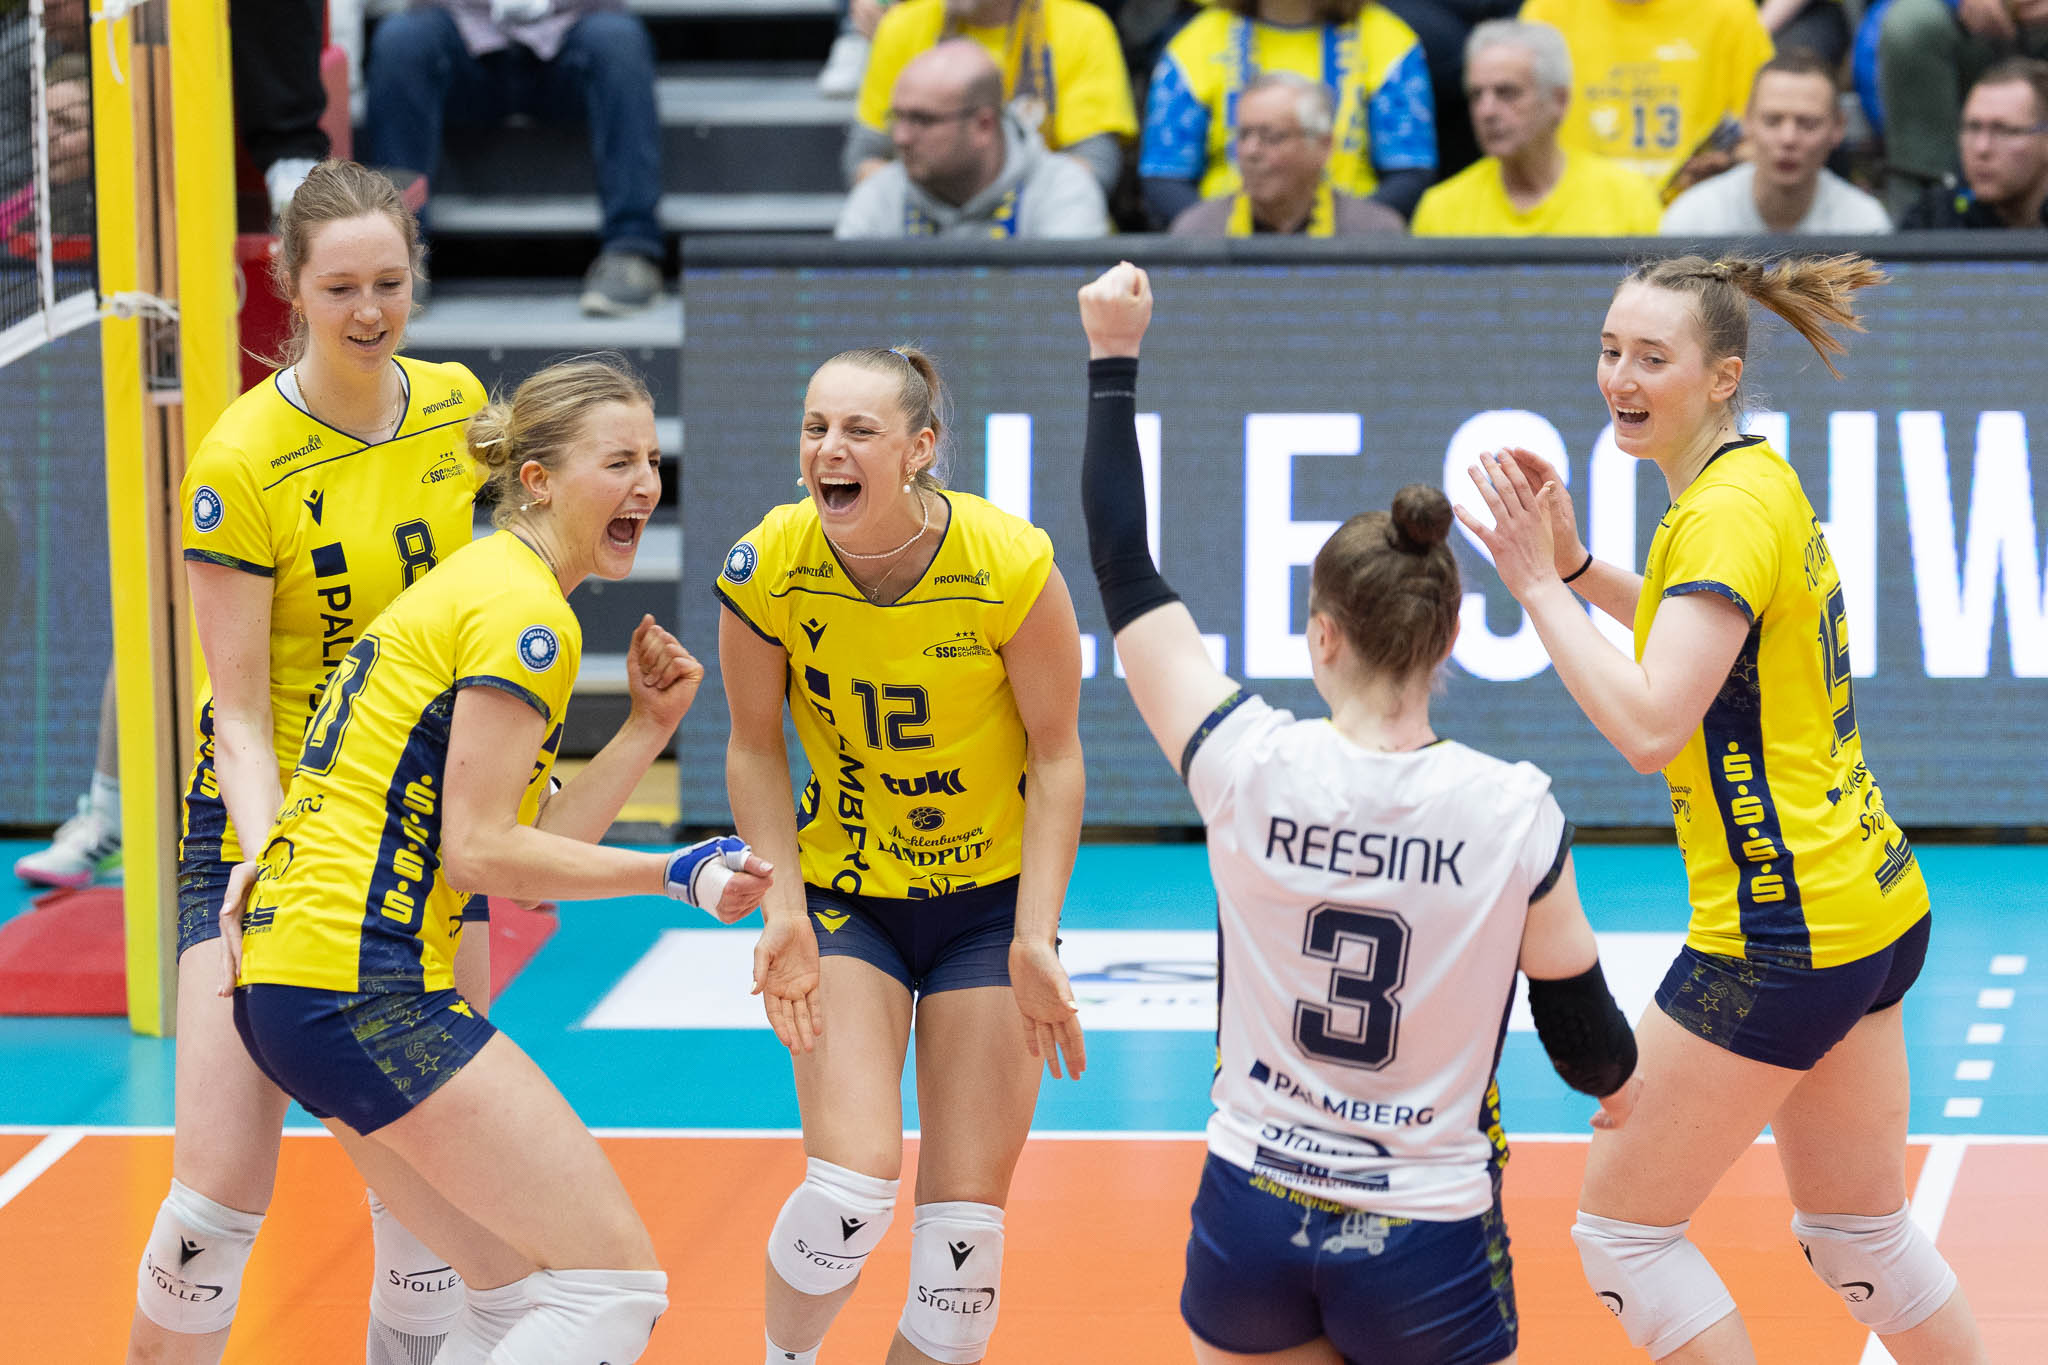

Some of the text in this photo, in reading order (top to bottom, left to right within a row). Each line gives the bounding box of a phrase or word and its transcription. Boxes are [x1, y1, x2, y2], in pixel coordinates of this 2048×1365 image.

[422, 396, 463, 416] PROVINZIAL
[270, 441, 321, 469] PROVINZIAL
[430, 468, 446, 484] SSC
[392, 517, 439, 592] 8
[935, 646, 957, 658] SSC
[851, 678, 935, 753] 12
[1265, 816, 1465, 887] REESINK
[1291, 900, 1412, 1073] 3
[793, 1239, 855, 1270] STOLLE
[388, 1268, 457, 1293] STOLLE
[917, 1284, 982, 1315] STOLLE
